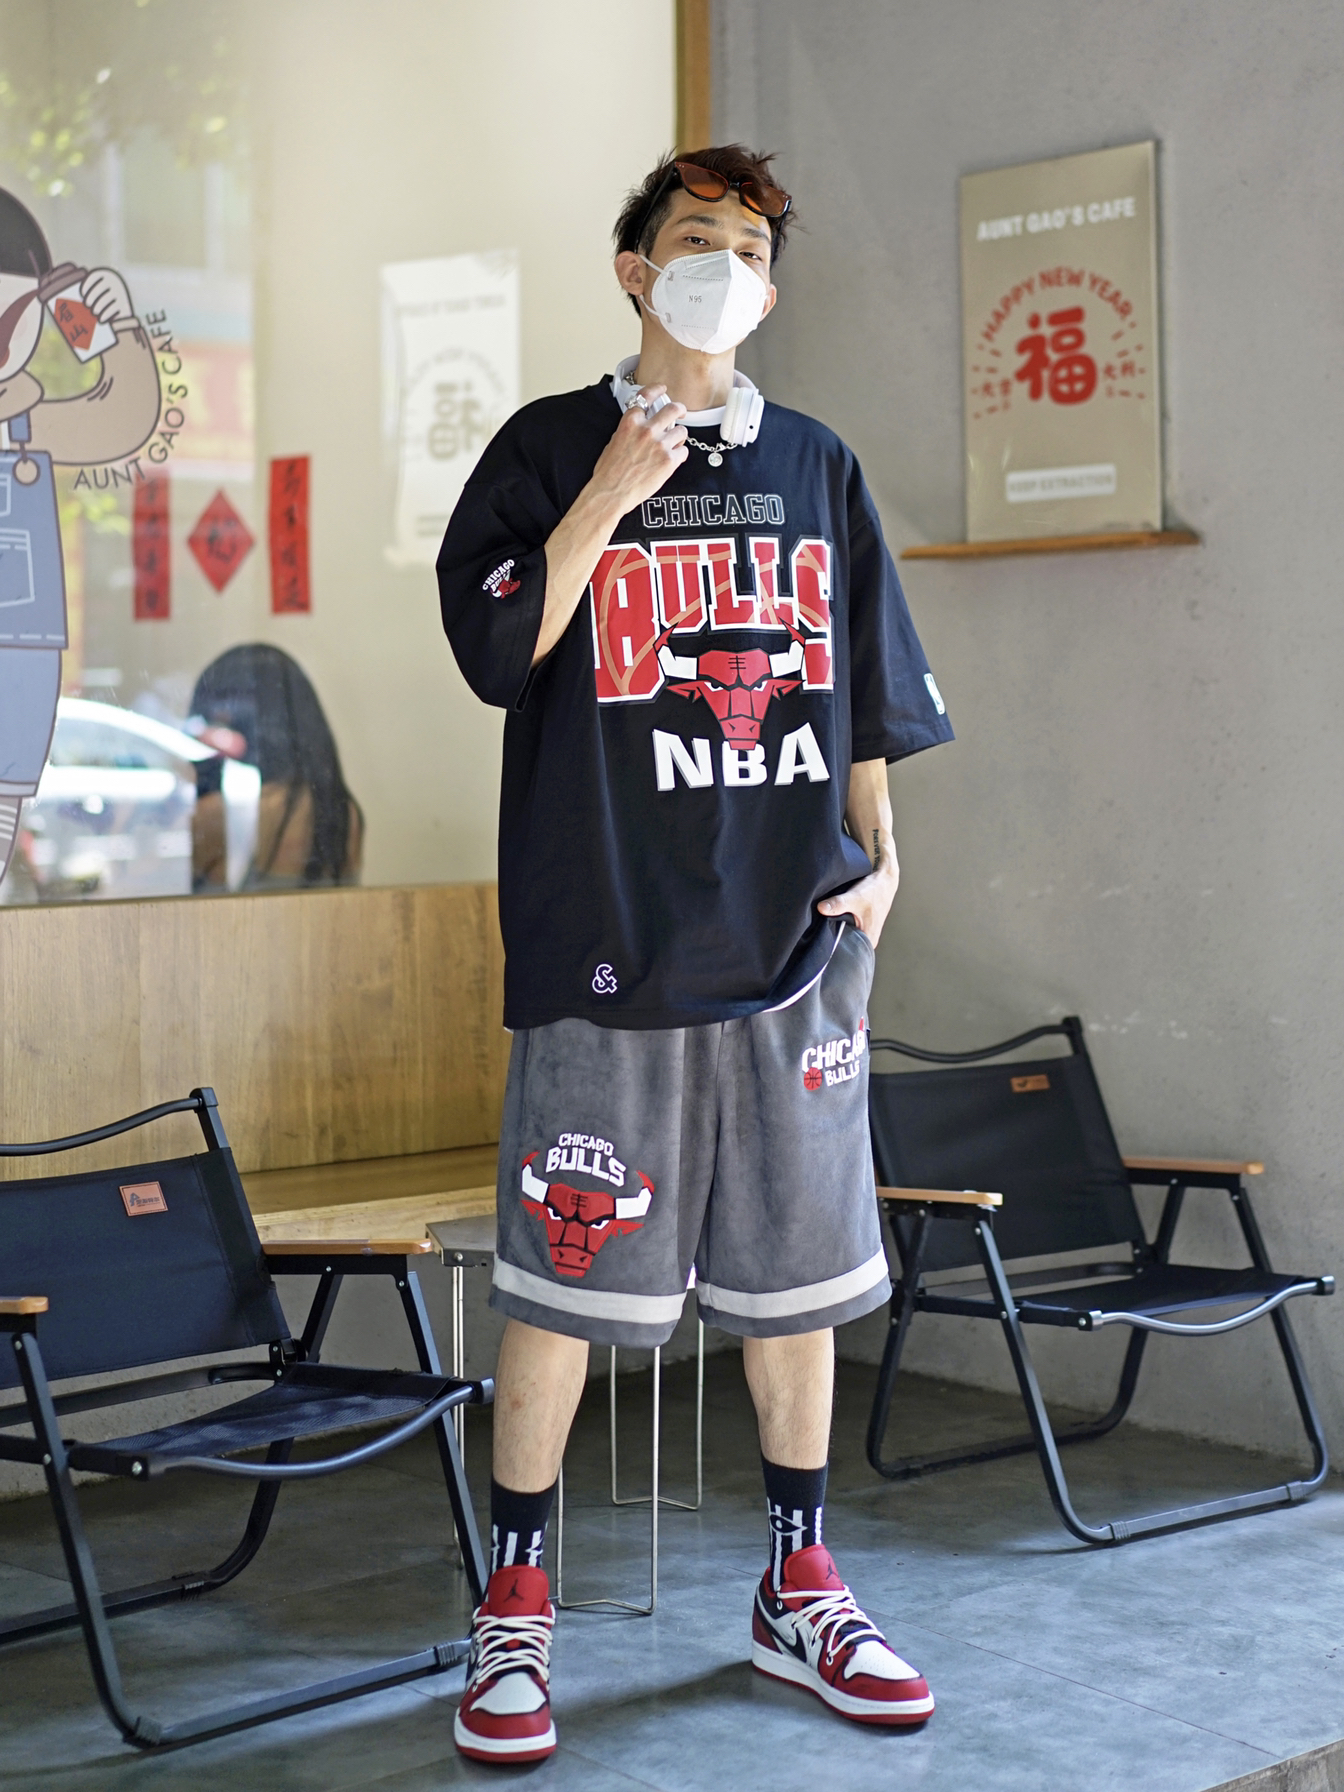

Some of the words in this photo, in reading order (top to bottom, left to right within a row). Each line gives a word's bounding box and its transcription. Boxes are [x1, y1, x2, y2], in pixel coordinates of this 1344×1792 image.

[977, 215, 1023, 240] AUNT
[1026, 205, 1085, 233] GAO'S
[1087, 196, 1135, 223] CAFE
[981, 276, 1035, 342] HAPPY
[1038, 265, 1086, 290] NEW
[1089, 271, 1132, 321] YEAR
[145, 309, 183, 376] CAFE
[1015, 306, 1097, 405] 福
[148, 384, 188, 464] GAO'S
[74, 456, 146, 491] AUNT
[641, 494, 786, 529] CHICAGO
[482, 559, 515, 590] CHICAGO
[652, 722, 831, 792] NBA
[545, 1146, 627, 1187] BULLS
[559, 1133, 614, 1156] CHICAGO
